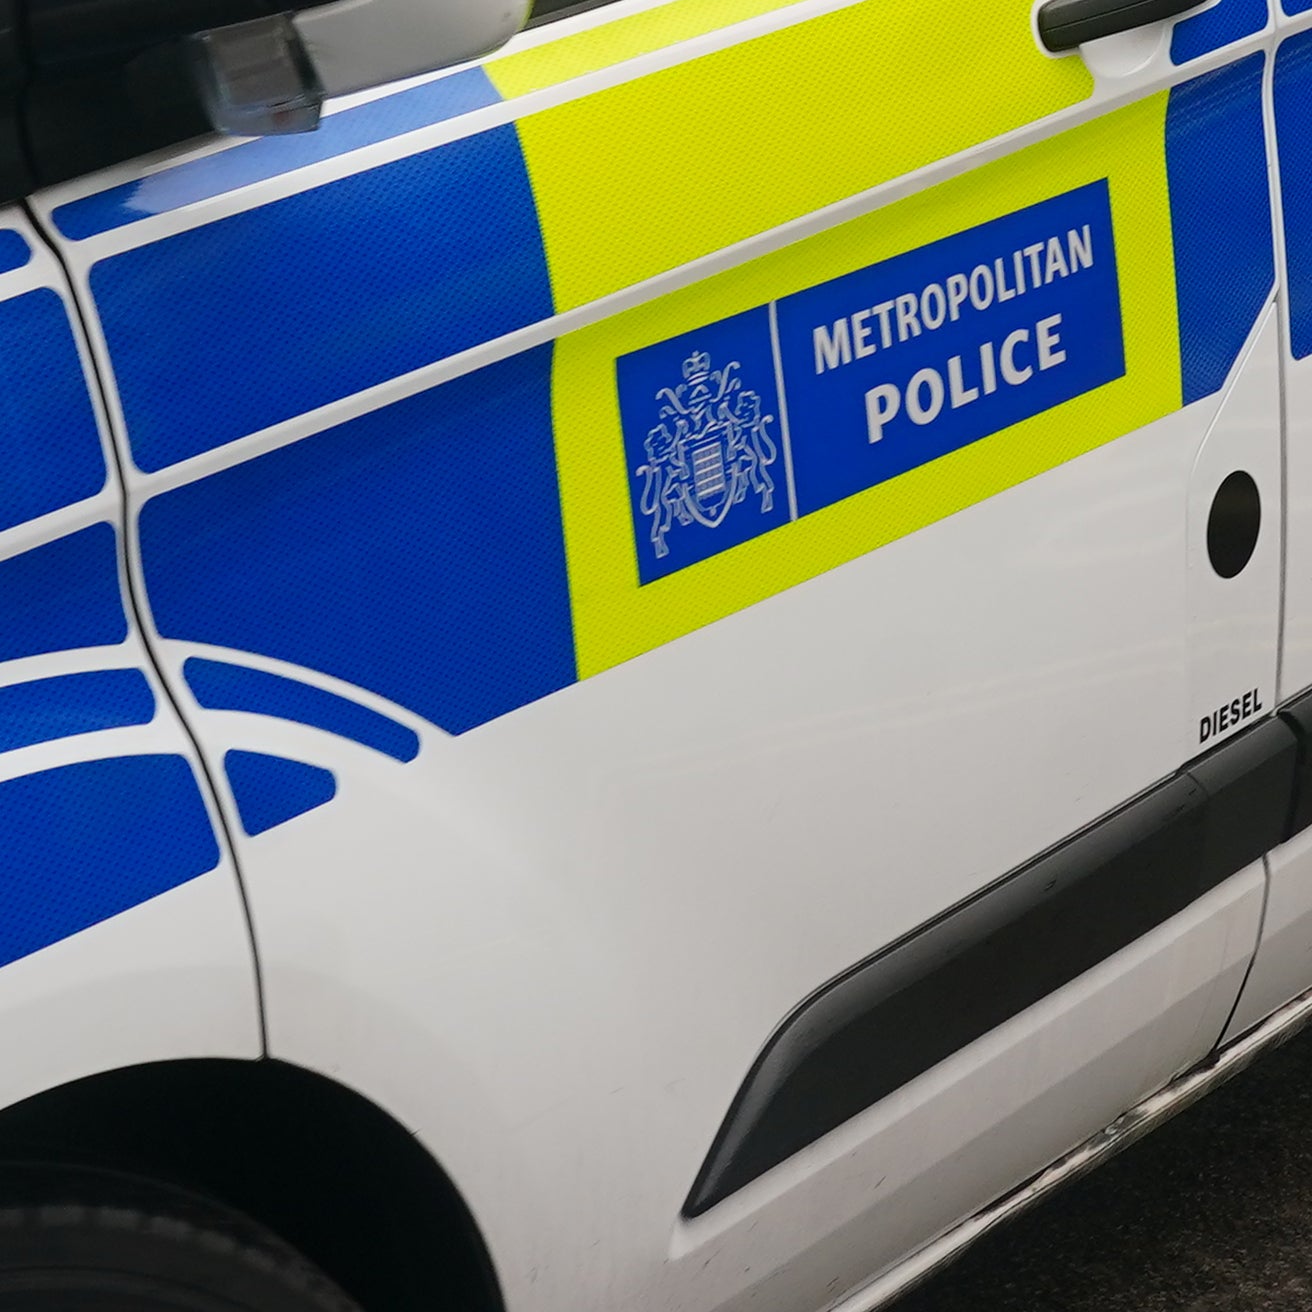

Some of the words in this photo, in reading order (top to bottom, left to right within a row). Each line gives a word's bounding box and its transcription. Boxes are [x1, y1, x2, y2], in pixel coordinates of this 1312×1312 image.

[812, 224, 1094, 375] METROPOLITAN
[864, 313, 1067, 444] POLICE
[1199, 688, 1262, 744] DIESEL
